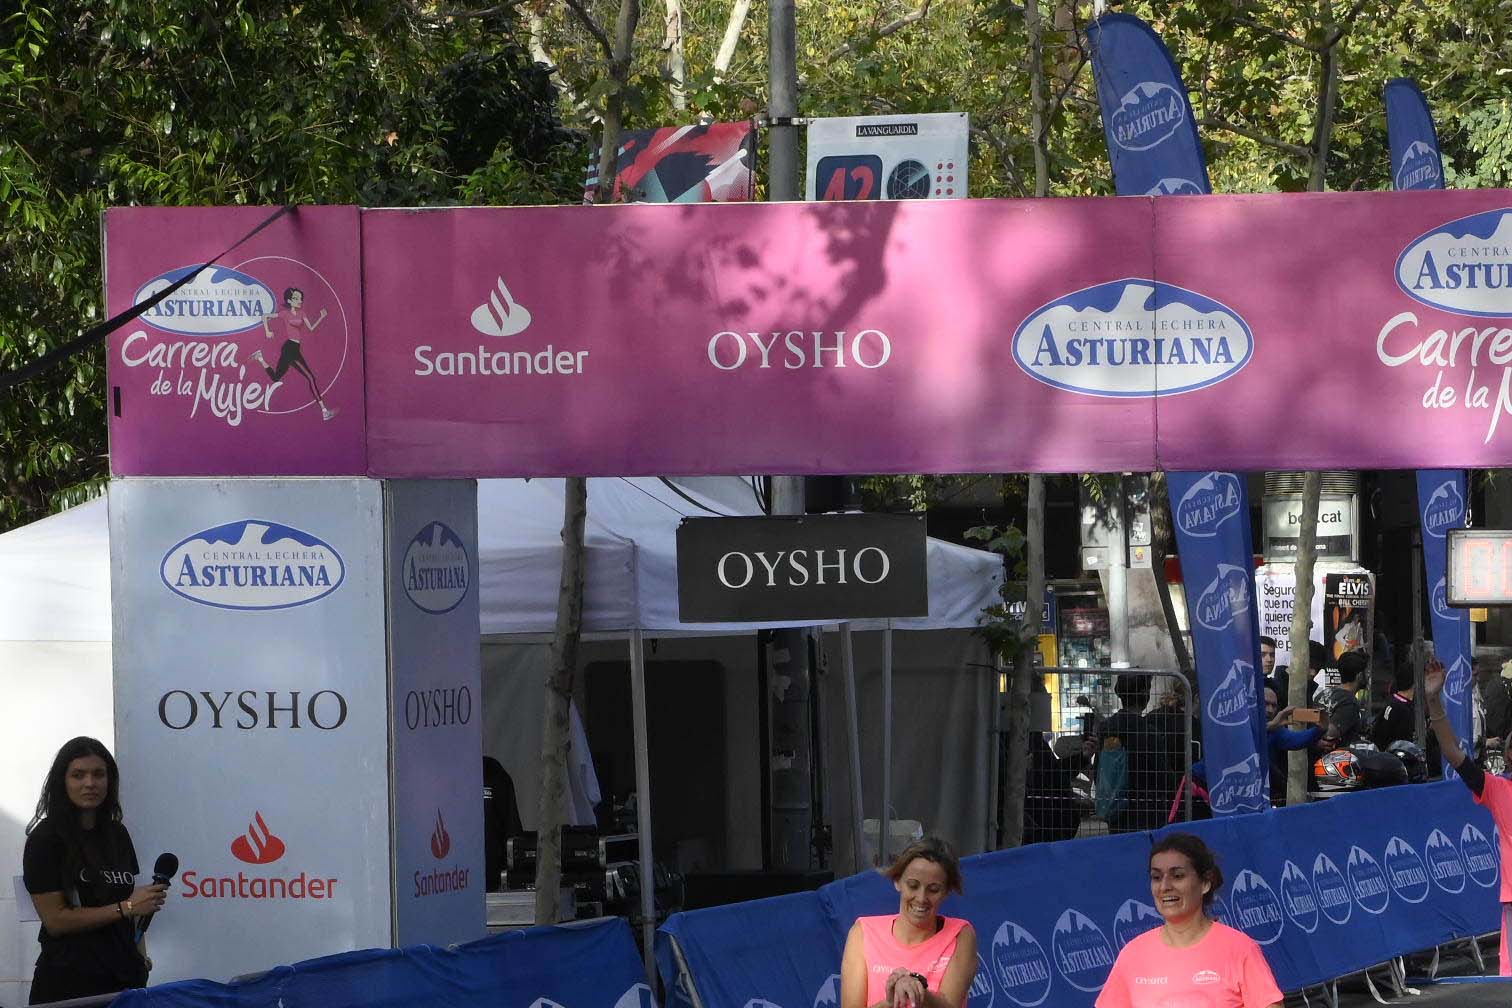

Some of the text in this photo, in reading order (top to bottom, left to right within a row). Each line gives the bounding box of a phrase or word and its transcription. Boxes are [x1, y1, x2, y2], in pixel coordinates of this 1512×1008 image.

[868, 124, 916, 135] VANGUARDIA
[145, 290, 264, 317] ASTURIANA
[1068, 319, 1227, 332] CENTRAL LECHERA
[121, 331, 239, 367] Carrera
[414, 343, 588, 376] Santander
[707, 329, 892, 371] OYSHO
[1031, 324, 1235, 367] ASTURIANA
[151, 364, 283, 426] de la Mujer
[1422, 371, 1456, 409] de
[1465, 367, 1490, 409] la
[176, 554, 331, 587] ASTURIANA
[203, 551, 325, 561] CENTRAL LECHERA
[717, 547, 890, 589] OYSHO
[408, 555, 465, 591] ASTURIANA
[1338, 582, 1369, 595] ELVIS
[1264, 599, 1280, 610] que
[158, 690, 348, 730] OYSHO
[405, 686, 471, 731] OYSHO
[79, 868, 134, 886] OSHO
[182, 871, 337, 899] Santander
[414, 867, 469, 898] Santander
[1000, 955, 1048, 990] ASTURIANA
[1060, 942, 1112, 975] ASTURIANA
